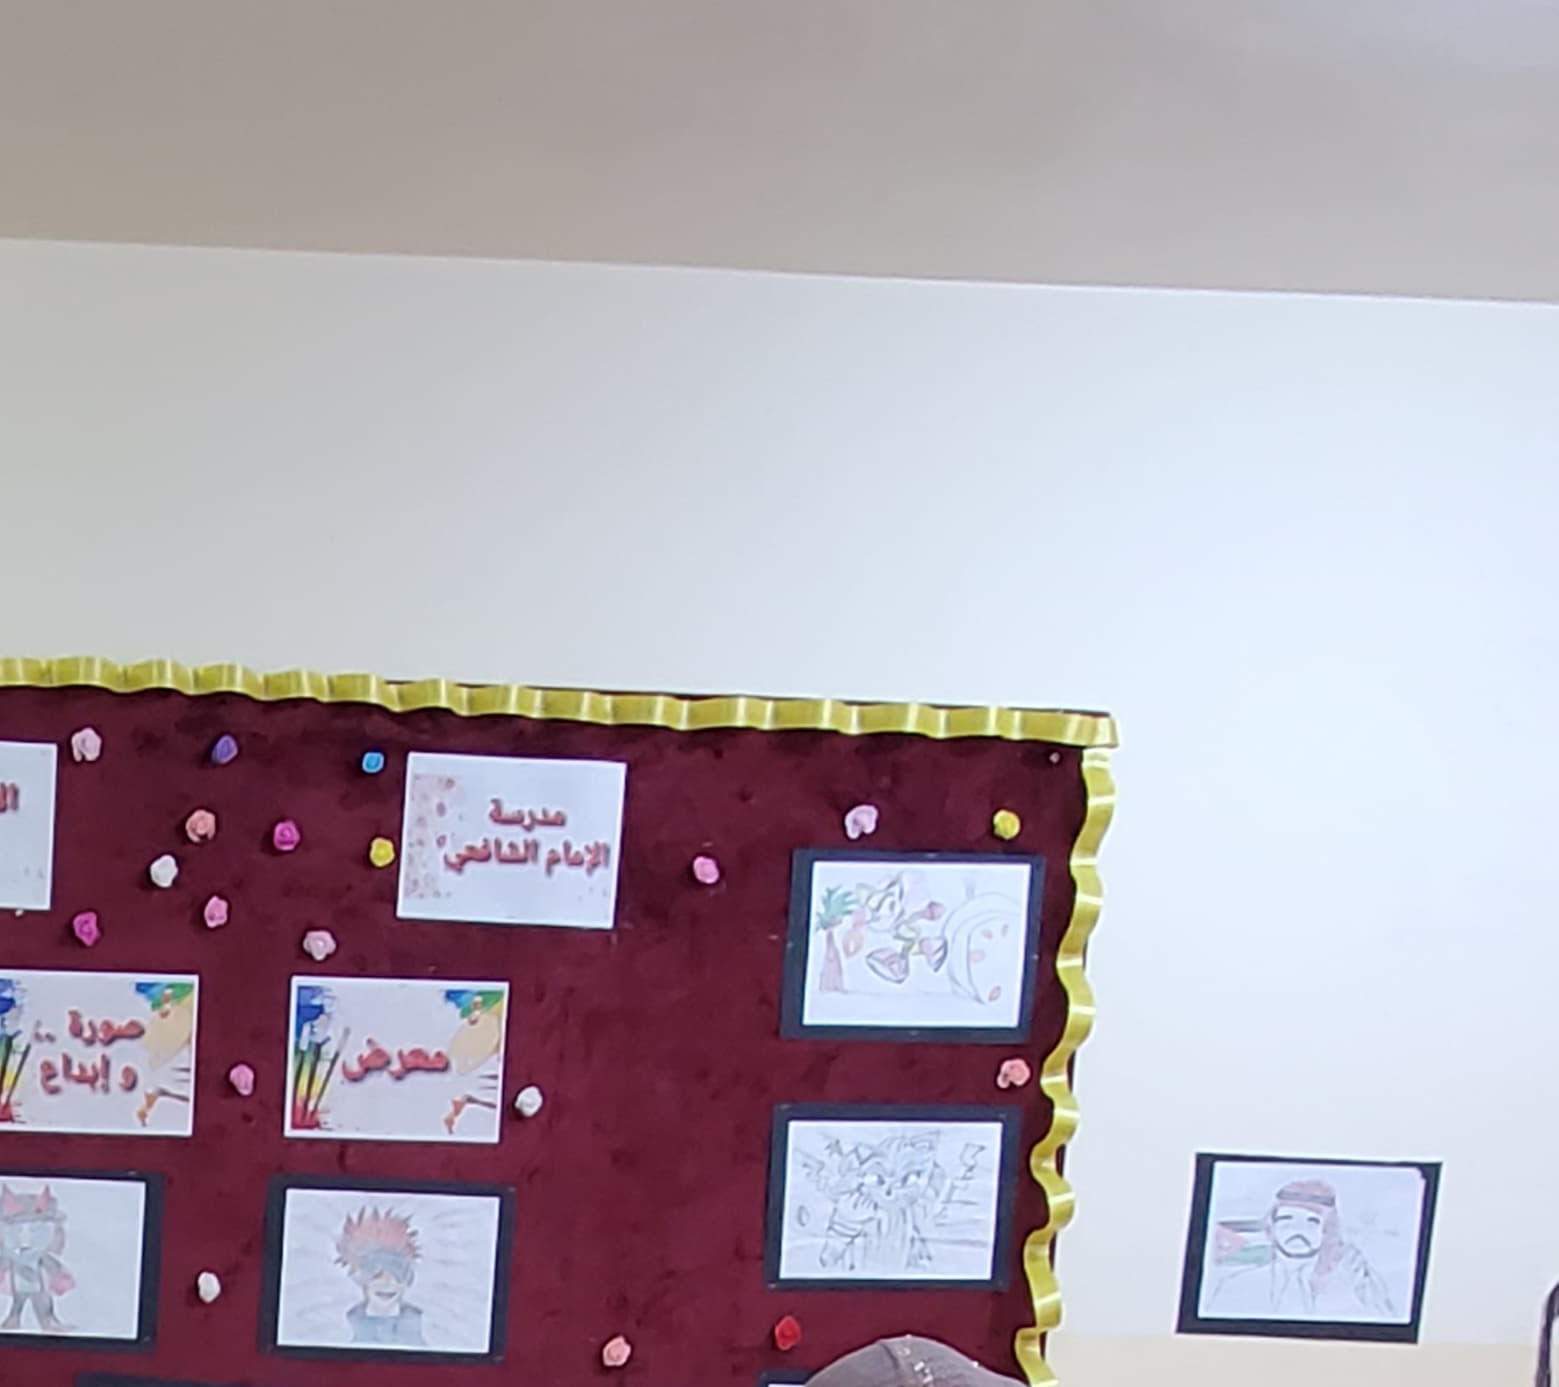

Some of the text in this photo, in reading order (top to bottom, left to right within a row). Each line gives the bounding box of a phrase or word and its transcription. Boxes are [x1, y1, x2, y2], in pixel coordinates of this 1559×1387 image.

[488, 797, 568, 832] مدرسة
[443, 836, 611, 878] الإمام الشافعي
[68, 1008, 146, 1047] صورة
[40, 1051, 139, 1096] و إبداع
[342, 1037, 451, 1083] معرض
